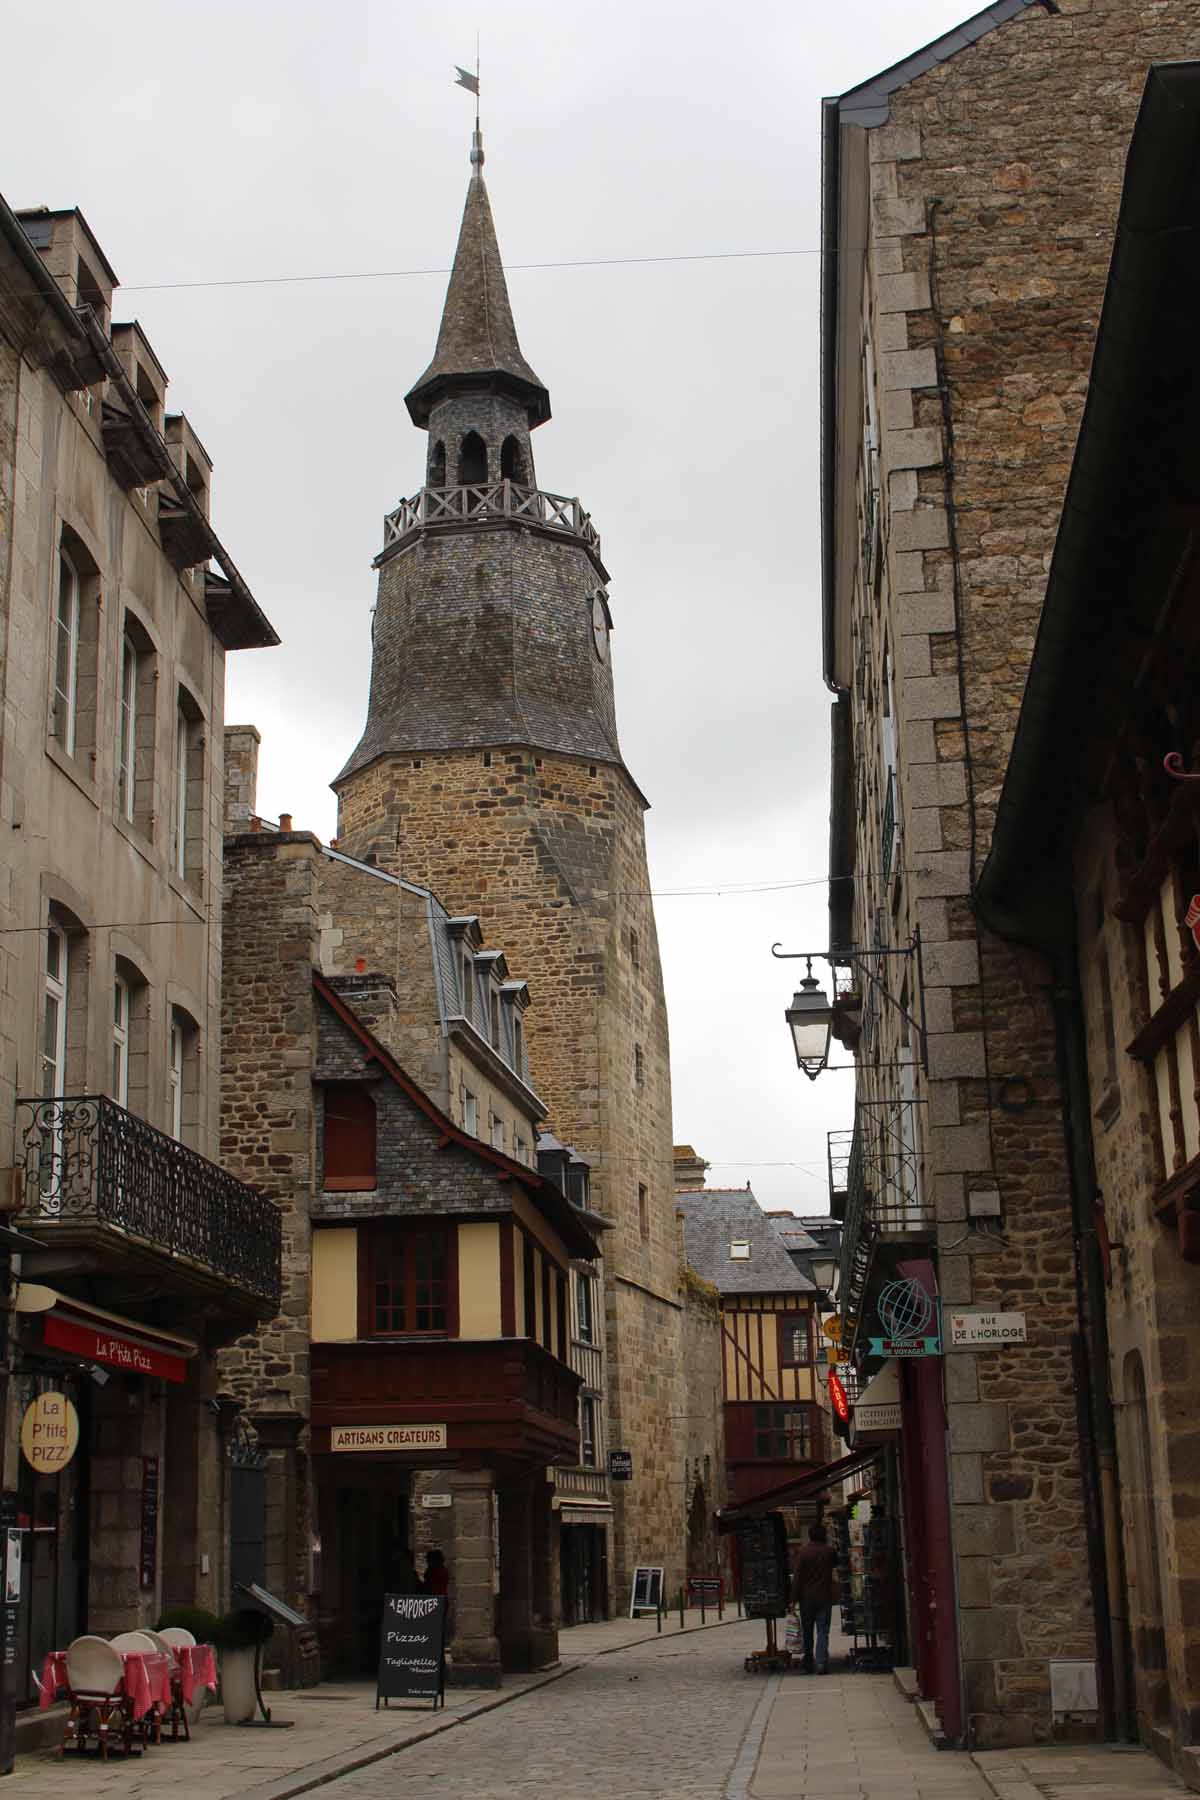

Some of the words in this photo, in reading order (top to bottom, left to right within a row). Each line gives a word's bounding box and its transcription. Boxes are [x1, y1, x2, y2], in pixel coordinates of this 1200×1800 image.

[980, 1317, 996, 1325] RUE
[954, 1330, 967, 1339] DE
[970, 1327, 1025, 1339] L'HORLOGE
[96, 1337, 108, 1357] La
[109, 1341, 132, 1366] P'tite
[831, 1376, 847, 1416] TABAC
[42, 1400, 60, 1415] La
[32, 1423, 68, 1440] P'tite
[337, 1431, 384, 1446] ARTISANS
[396, 1598, 438, 1619] EMPORTER
[387, 1631, 429, 1643] Pizzas
[384, 1657, 437, 1667] Tagliatelles
